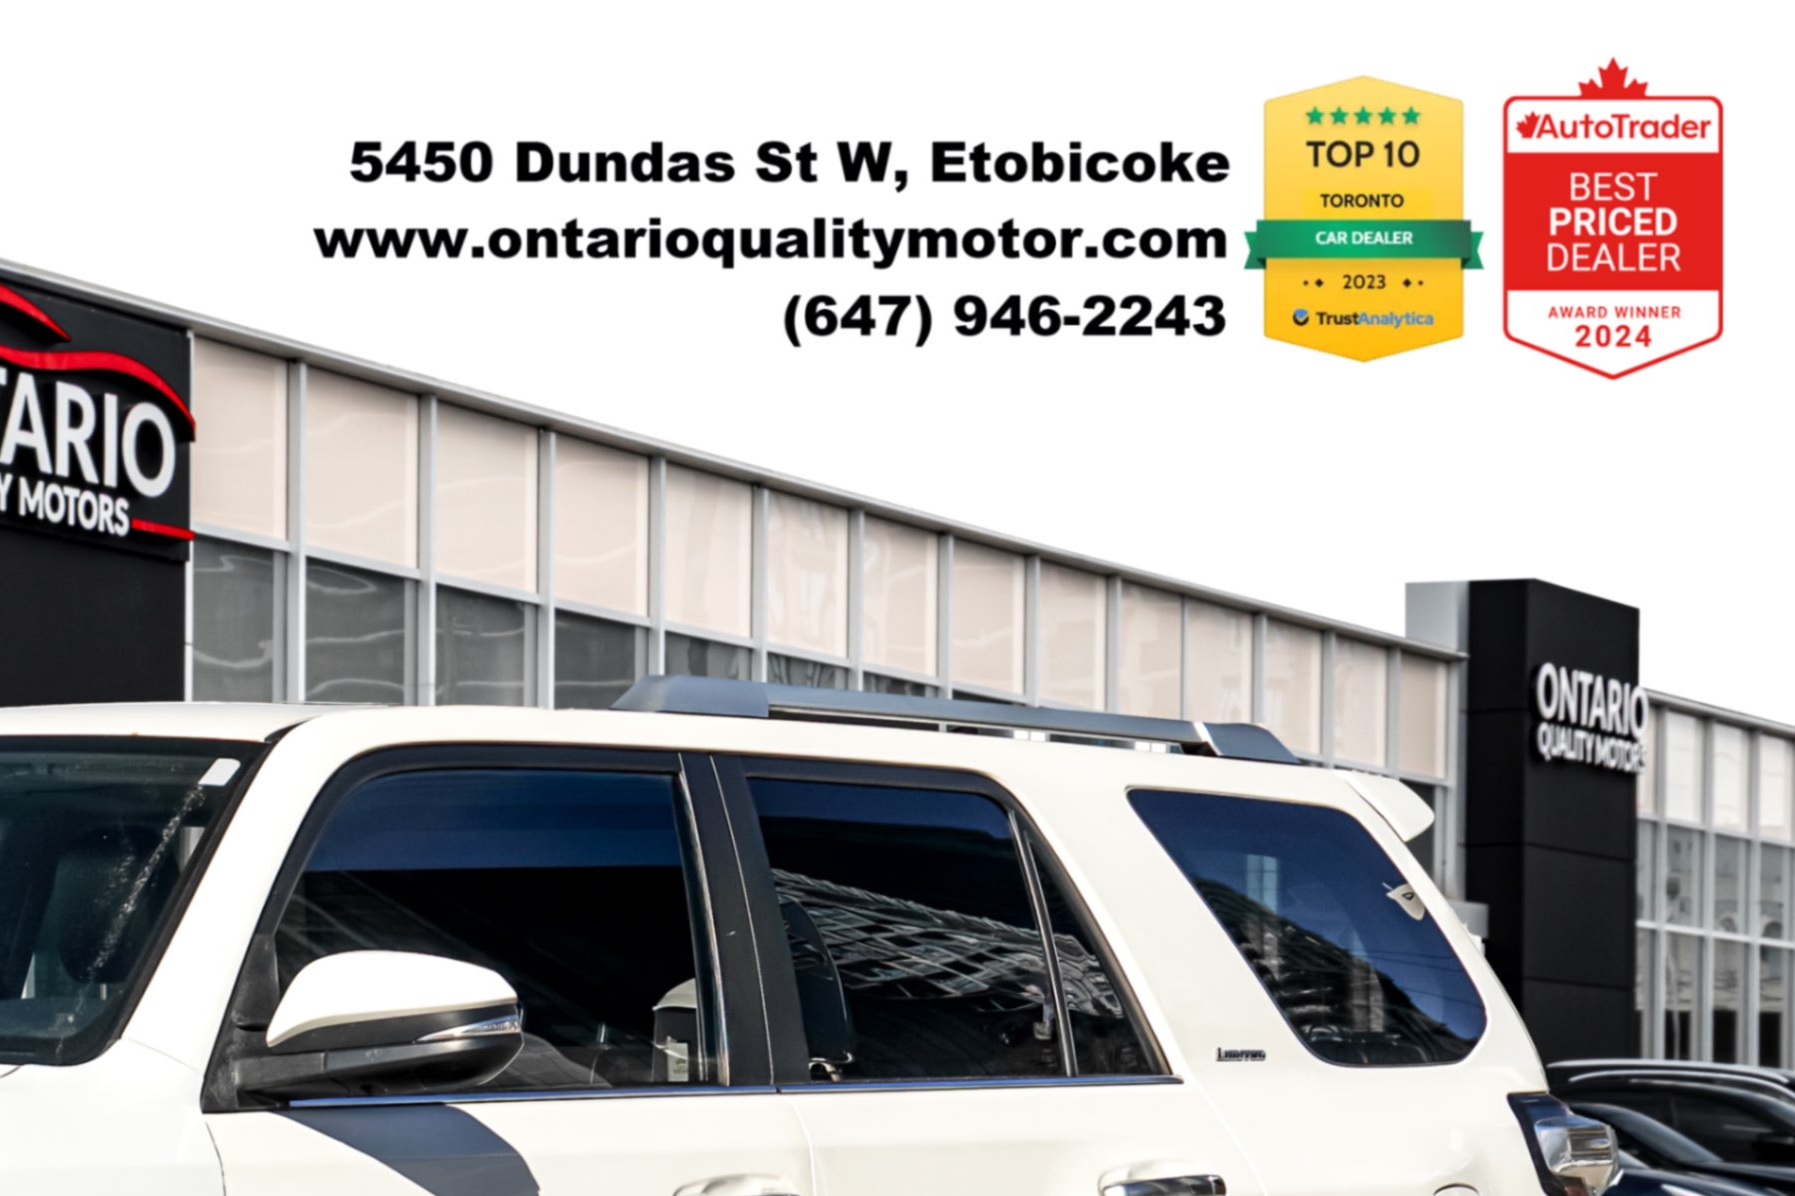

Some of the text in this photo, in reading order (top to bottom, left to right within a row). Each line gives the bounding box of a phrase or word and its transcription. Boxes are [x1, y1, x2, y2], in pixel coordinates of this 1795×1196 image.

[19, 476, 130, 536] MOTORS
[1536, 661, 1649, 741] ONTARIO
[1536, 721, 1594, 763] QUALITY
